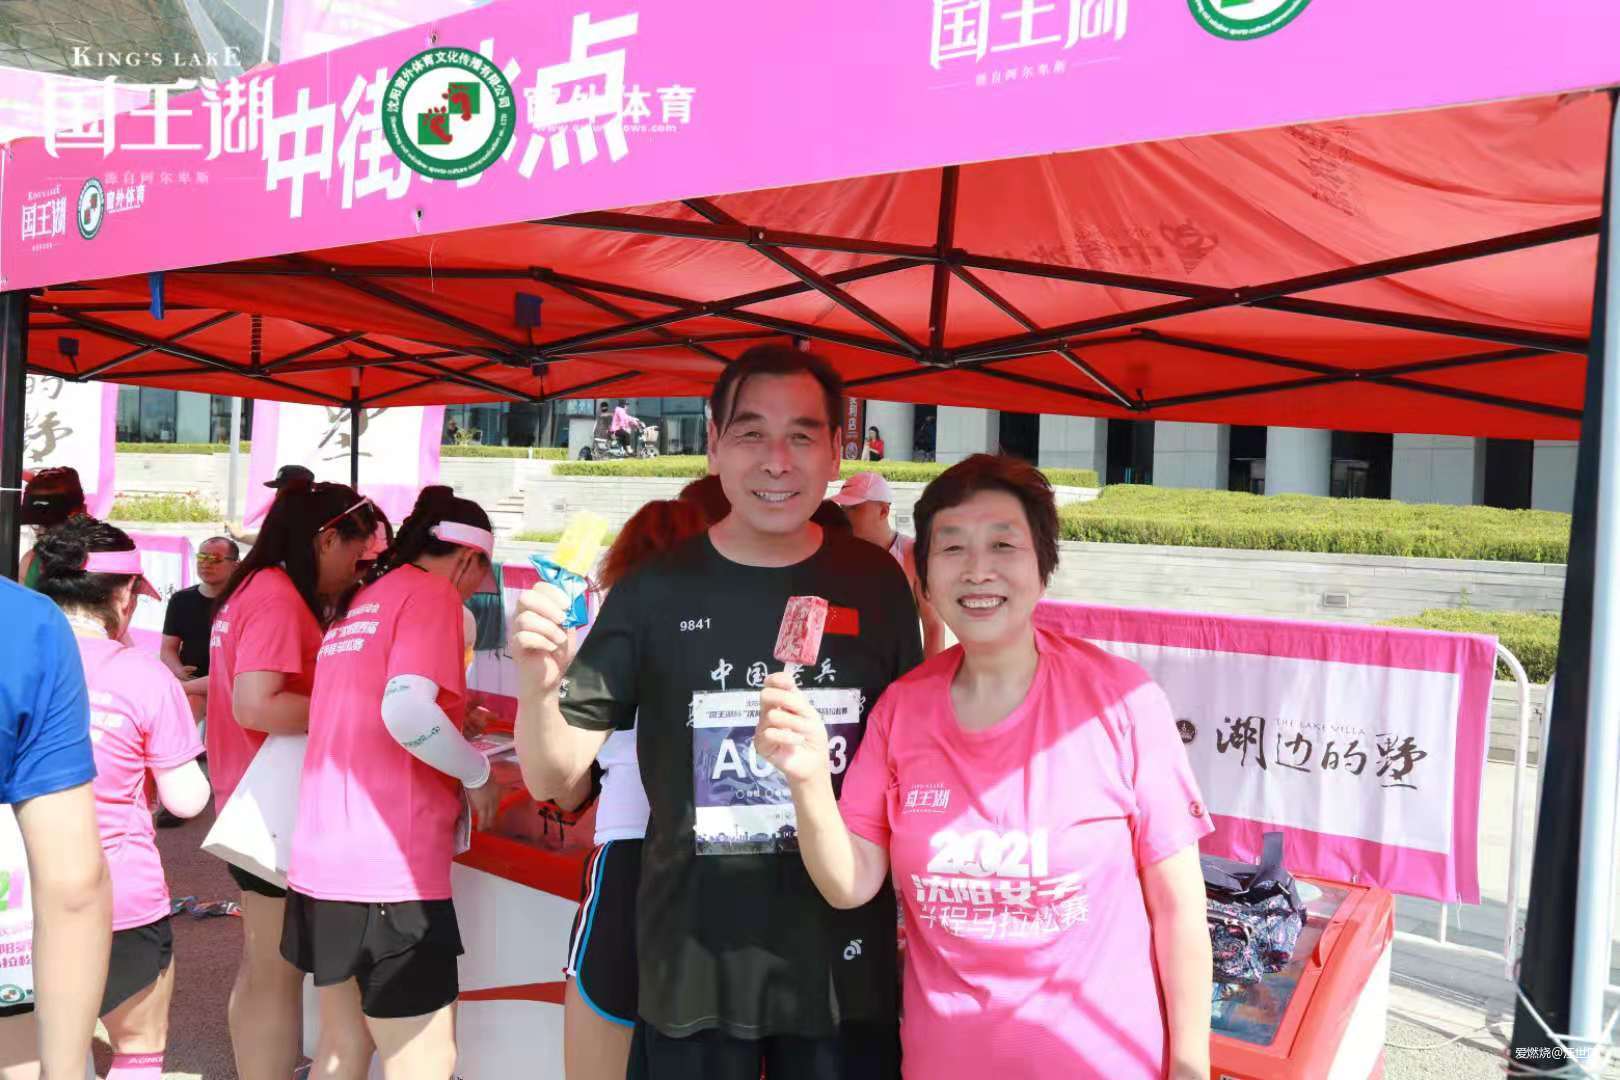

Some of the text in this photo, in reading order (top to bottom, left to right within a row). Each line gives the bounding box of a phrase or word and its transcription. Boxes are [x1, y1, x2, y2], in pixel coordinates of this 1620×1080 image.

[21, 196, 67, 241] 国王湖
[679, 618, 712, 632] 9841
[711, 735, 848, 780] A03
[927, 829, 1049, 878] 2021
[911, 870, 1090, 909] 沈阳女子
